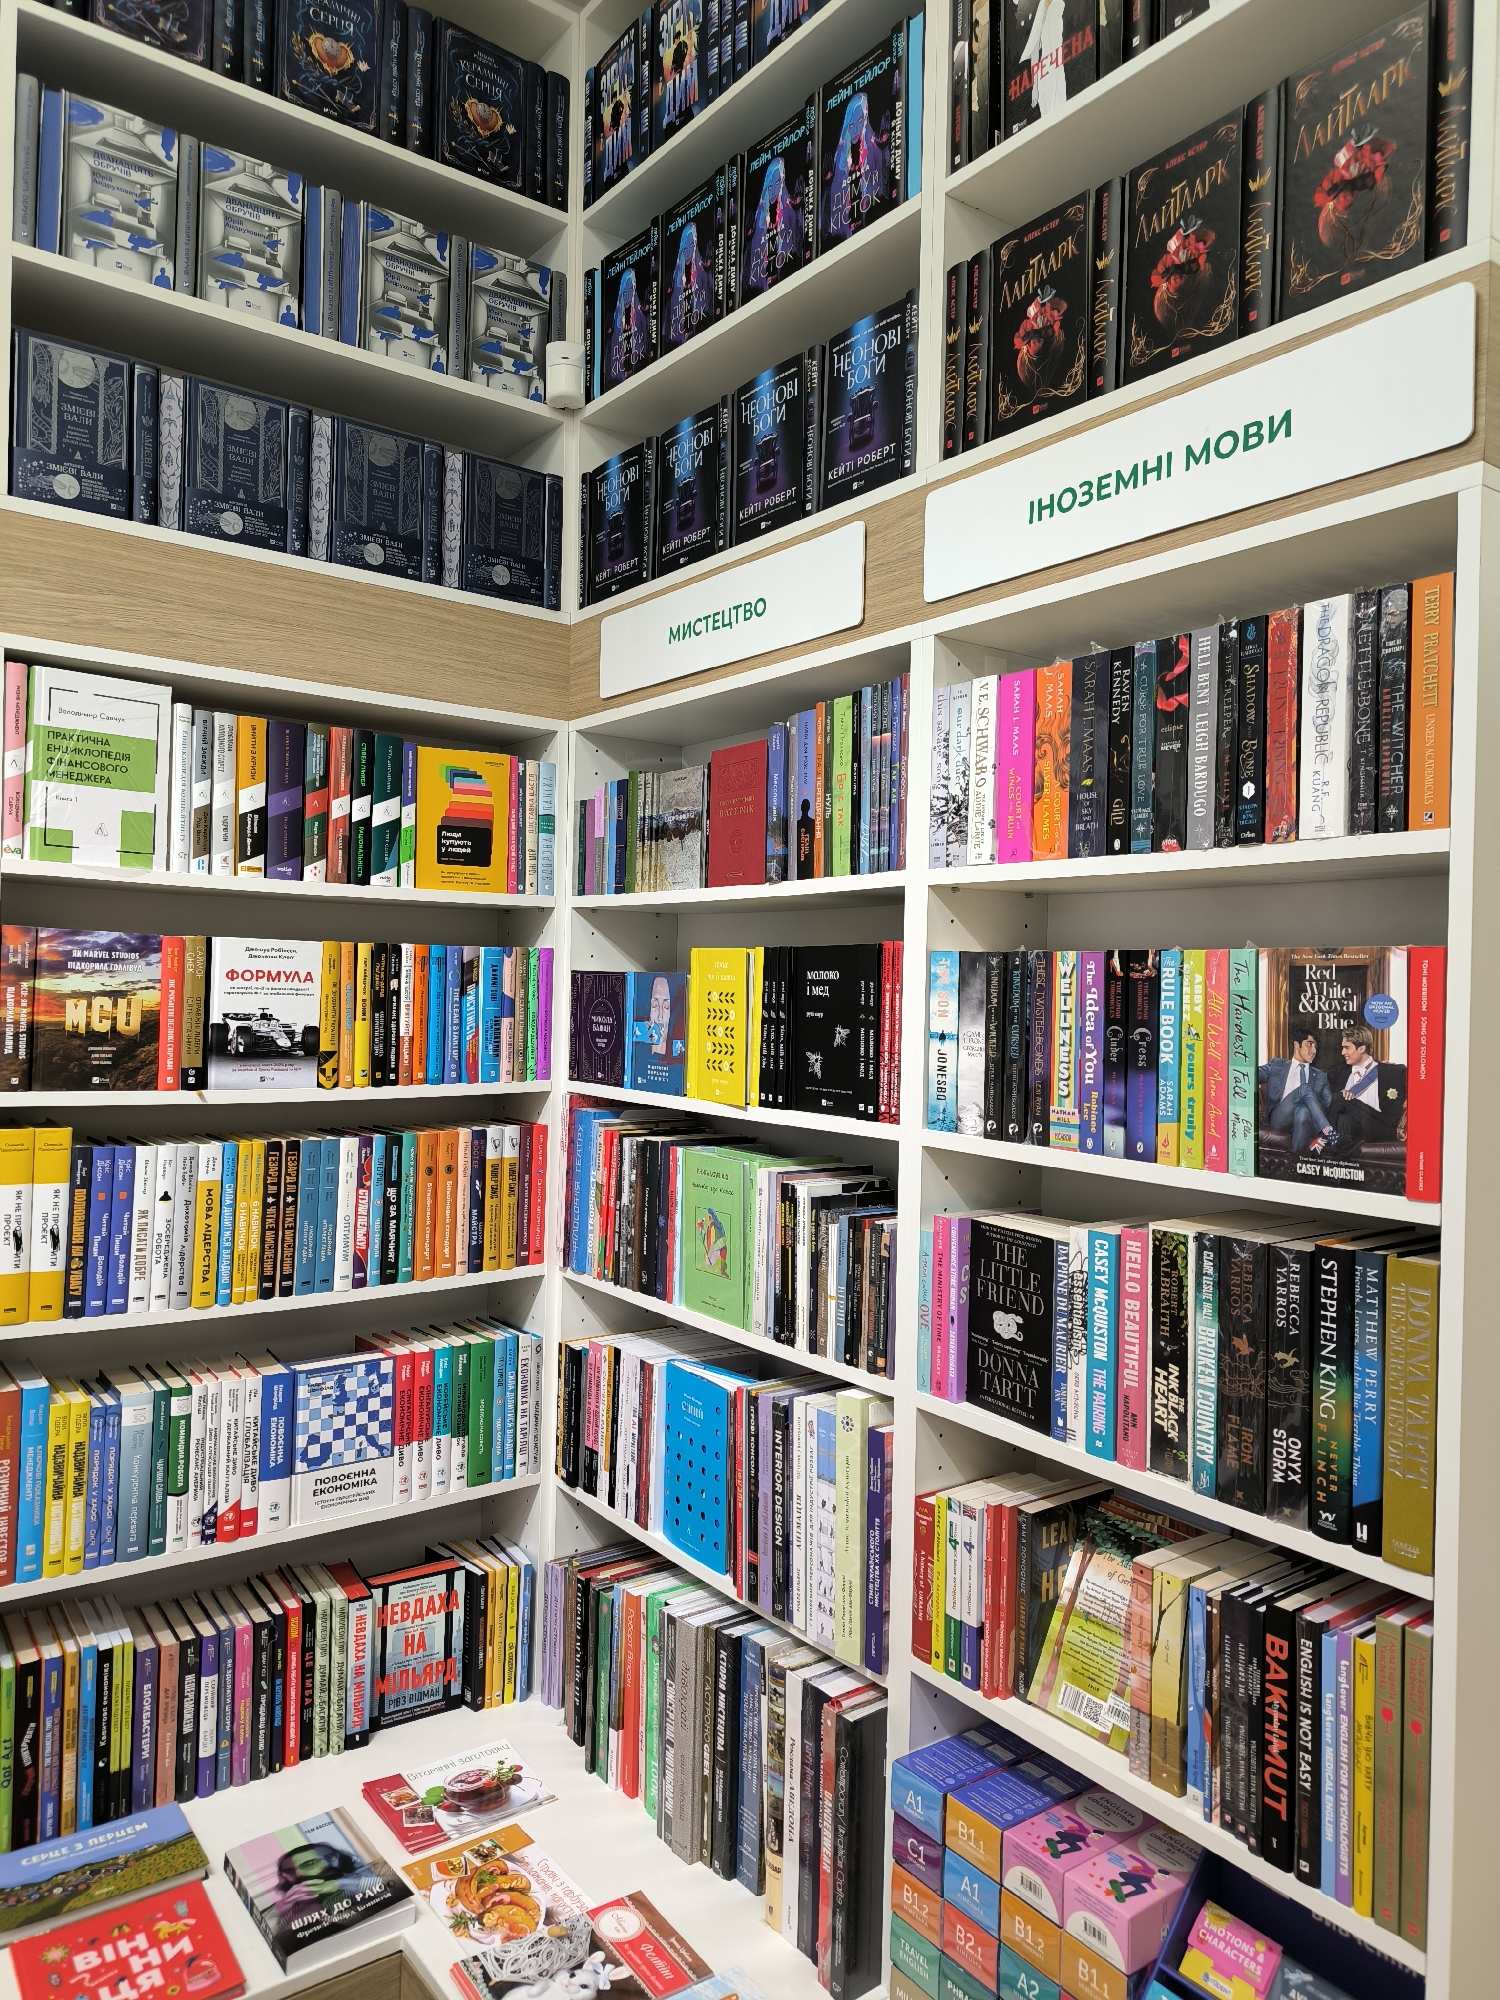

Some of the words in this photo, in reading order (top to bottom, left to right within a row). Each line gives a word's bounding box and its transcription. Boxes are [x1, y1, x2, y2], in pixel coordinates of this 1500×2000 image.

[1009, 26, 1095, 101] НАРЕЧЕНА
[826, 84, 853, 113] ЛЕЙНІ
[853, 57, 891, 90] ТЕЙЛОР
[92, 149, 155, 179] ДВАНАДЦЯТЬ
[92, 158, 133, 177] ОБРУЧІВ
[830, 193, 881, 234] КІСТОК
[833, 326, 901, 376] НЕОНОВІ
[847, 356, 886, 390] БОГИ
[60, 402, 96, 417] ЗМІЄВІ
[63, 413, 92, 425] ВАЛИ
[828, 463, 853, 481] КЕЙТІ
[856, 443, 896, 469] РОБЕРТ
[1028, 452, 1172, 525] ІНОЗЕМНІ
[1185, 408, 1292, 472] МОВИ
[668, 598, 767, 645] МИСТЕЦТВО
[1321, 603, 1330, 624] THE
[1424, 585, 1441, 625] TERRY
[1198, 635, 1211, 670] HELL
[1316, 627, 1331, 693] DRAGON
[1422, 632, 1439, 707] PRATCHETT
[979, 683, 989, 706] V.E.
[1013, 680, 1021, 715] SARAH
[1111, 661, 1122, 725] KENNEDY
[1122, 668, 1130, 712] RAVEN
[1198, 672, 1210, 706] BENT
[1243, 664, 1260, 724] SHADOW
[58, 707, 97, 720] Володимир
[1160, 723, 1184, 738] eclipse
[1195, 713, 1209, 751] LEIGH
[1314, 699, 1330, 764] REPUBLIC
[1425, 713, 1435, 747] UNSEEN
[47, 743, 131, 762] ЕНЦИКЛОПЕДІЯ
[48, 730, 110, 747] ПРАКТИЧНА
[975, 707, 990, 787] SCHWAB
[46, 769, 112, 785] МЕНЕДЖЕРА
[47, 756, 128, 774] ФІНАНСОВОГО
[1239, 739, 1258, 779] BONE
[1424, 748, 1435, 804] ACADEMICALS
[1076, 792, 1098, 800] HOUSE
[1193, 755, 1208, 817] BARDUGO
[1110, 799, 1124, 826] GILD
[442, 838, 472, 848] купують
[448, 846, 471, 854] людей
[68, 961, 108, 971] ПІДКОРИЛА
[110, 963, 143, 973] ГОЛЛІВУД
[72, 950, 82, 958] ЯК
[84, 950, 110, 959] MARVEL
[112, 951, 140, 960] STUDIOS
[1086, 961, 1096, 986] The
[1163, 957, 1175, 967] The
[1232, 960, 1246, 985] The
[1305, 964, 1336, 980] Red
[226, 969, 314, 984] ФОРМУЛА
[807, 970, 839, 981] молоко
[812, 987, 829, 997] мед
[1161, 968, 1176, 1009] RULE
[1305, 981, 1352, 998] White
[65, 996, 143, 1036] MCU
[1086, 988, 1099, 1032] Idea
[1232, 993, 1252, 1064] Hardest
[1318, 1013, 1354, 1030] Blue
[1058, 961, 1075, 1098] WELLNESS
[1086, 1036, 1095, 1049] of
[1160, 1015, 1175, 1065] BOOK
[1084, 1048, 1098, 1085] You
[1232, 1068, 1250, 1100] Fall
[1297, 1163, 1320, 1176] CASEY
[1323, 1166, 1365, 1181] McQUISTON
[72, 1188, 87, 1242] ПОЛЮВАННЯ
[122, 1211, 130, 1235] Читай
[138, 1209, 149, 1222] ЯК
[205, 1188, 214, 1220] МОВА
[71, 1243, 83, 1257] НА
[114, 1234, 122, 1255] Пиши
[135, 1224, 148, 1252] ПИСАТИ
[154, 1233, 162, 1265] РОБОТА
[162, 1218, 171, 1279] ЗОСЕРЕДЖЕНА
[201, 1221, 213, 1284] ЛІДЕРСТВА
[341, 1215, 350, 1262] ОПТИМУМ
[992, 1241, 1029, 1268] THE
[117, 1254, 125, 1285] Володій
[134, 1255, 146, 1281] ДОБРЕ
[980, 1259, 1042, 1294] LITTLE
[1094, 1240, 1109, 1284] CASEY
[1125, 1240, 1142, 1293] HELLO
[69, 1271, 82, 1296] УВАГУ
[977, 1278, 1044, 1316] FRIEND
[1094, 1287, 1109, 1361] McQUISTON
[1320, 1258, 1337, 1358] STEPHEN
[1366, 1268, 1379, 1362] MATTHEW
[1123, 1299, 1141, 1389] BEAUTIFUL
[1197, 1325, 1215, 1384] BROKEN
[977, 1348, 1040, 1389] DONNA
[1093, 1368, 1107, 1389] THE
[980, 1370, 1036, 1408] TARTT
[1319, 1361, 1337, 1420] KING
[1364, 1367, 1378, 1426] PERRY
[1092, 1392, 1107, 1436] PAIRING
[1195, 1389, 1215, 1466] COUNTRY
[177, 1419, 186, 1461] КОМАНДНА
[1272, 1428, 1286, 1484] STORM
[52, 1443, 66, 1501] НАДЗВИЧАЙНА
[176, 1461, 185, 1488] РОБОТА
[314, 1468, 377, 1487] ПОВОЄННА
[774, 1430, 783, 1496] INTERIOR
[1287, 1438, 1302, 1484] ONYX
[313, 1478, 378, 1498] ЕКОНОМІКА
[49, 1501, 63, 1555] ГОСТИННІСТЬ
[774, 1496, 783, 1546] DESIGN
[377, 1589, 459, 1628] НЕВДАХА
[403, 1630, 427, 1656] НА
[627, 1608, 635, 1648] Роберт
[375, 1656, 458, 1699] МІЛЬЯРД
[718, 1650, 728, 1690] ІСТОРІЯ
[1300, 1639, 1313, 1698] ENGLISH
[389, 1696, 407, 1709] РІВЗ
[409, 1687, 440, 1704] ВІДМАН
[1300, 1702, 1311, 1720] IS
[141, 1684, 152, 1760] БЛОКБАСТЕРИ
[717, 1690, 726, 1751] МИСТЕЦТВА
[1263, 1633, 1288, 1822] BAKHMUT
[1299, 1722, 1311, 1753] NOT
[406, 1759, 457, 1782] Вітамінні
[459, 1743, 510, 1766] заготовки
[1297, 1758, 1311, 1792] EASY
[1323, 1745, 1333, 1792] MEDICAL
[906, 1790, 924, 1815] A1
[1088, 1796, 1136, 1827] COLLOCATIONS
[1100, 1795, 1136, 1819] ENGLISH
[1323, 1796, 1333, 1842] ENGLISH
[21, 1842, 69, 1868] СЕРЦЕ
[74, 1841, 85, 1852] З
[88, 1820, 149, 1850] ПЕРЦЕМ
[822, 1790, 832, 1873] DANDERWEAR
[958, 1820, 985, 1854] B1.1
[907, 1838, 926, 1866] C1
[291, 1908, 329, 1932] ШЛЯХ
[332, 1898, 351, 1913] ДО
[354, 1883, 384, 1904] РАЮ
[960, 1876, 980, 1903] A1
[71, 1932, 150, 1974] ВІН
[129, 1935, 195, 1974] НИ
[900, 1937, 929, 1969] TRAVEL
[956, 1924, 983, 1961] B2.1
[1198, 1929, 1263, 1976] CHARACTERS
[1203, 1919, 1254, 1956] EMOTIONS
[1256, 1955, 1265, 1964] &
[899, 1950, 929, 1980] ENGLISH
